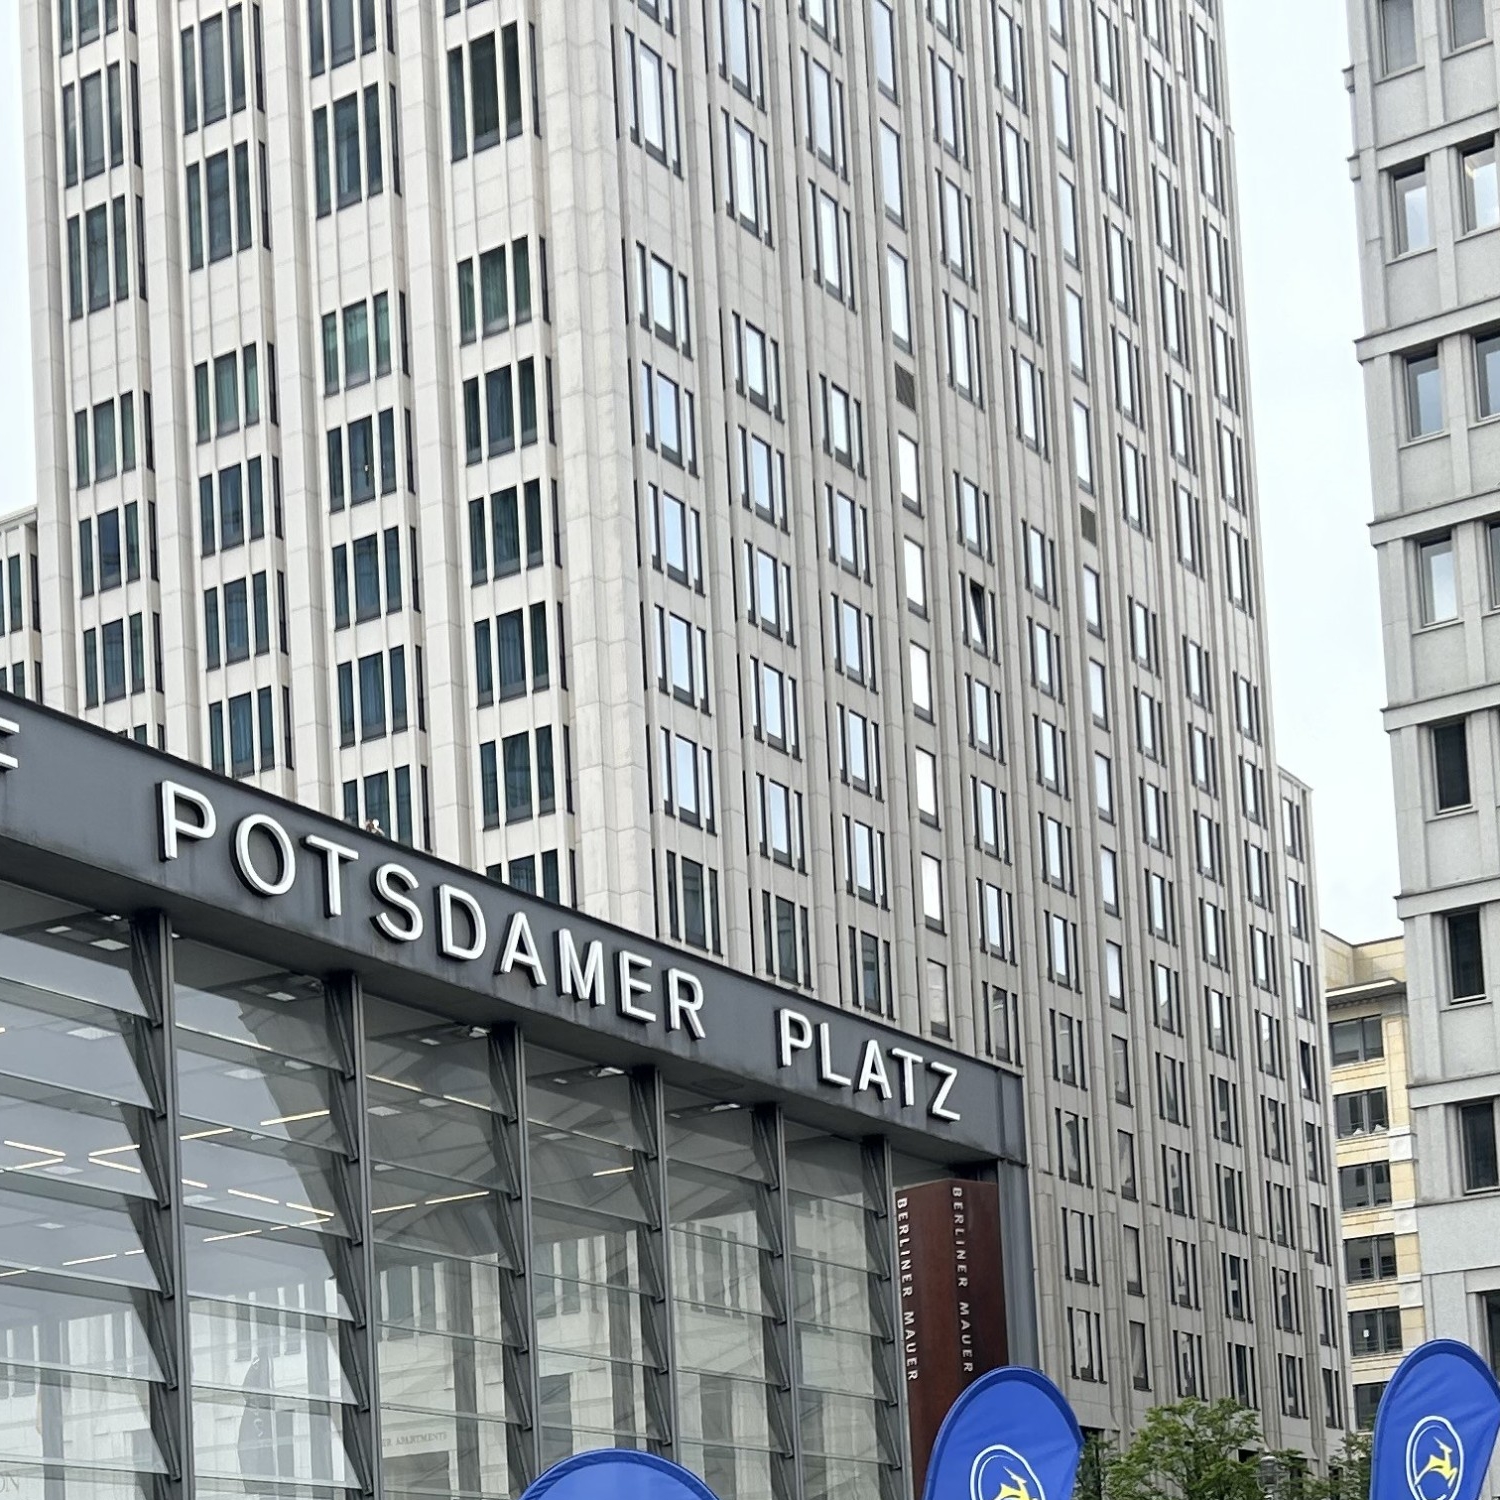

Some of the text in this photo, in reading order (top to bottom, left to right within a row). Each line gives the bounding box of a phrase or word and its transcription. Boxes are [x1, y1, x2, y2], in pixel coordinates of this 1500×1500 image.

[158, 779, 706, 1042] POTSDAMER
[776, 1008, 961, 1123] PLATZ
[897, 1197, 918, 1381] BERLINER MAUER
[953, 1187, 974, 1372] BERLINER MAUER
